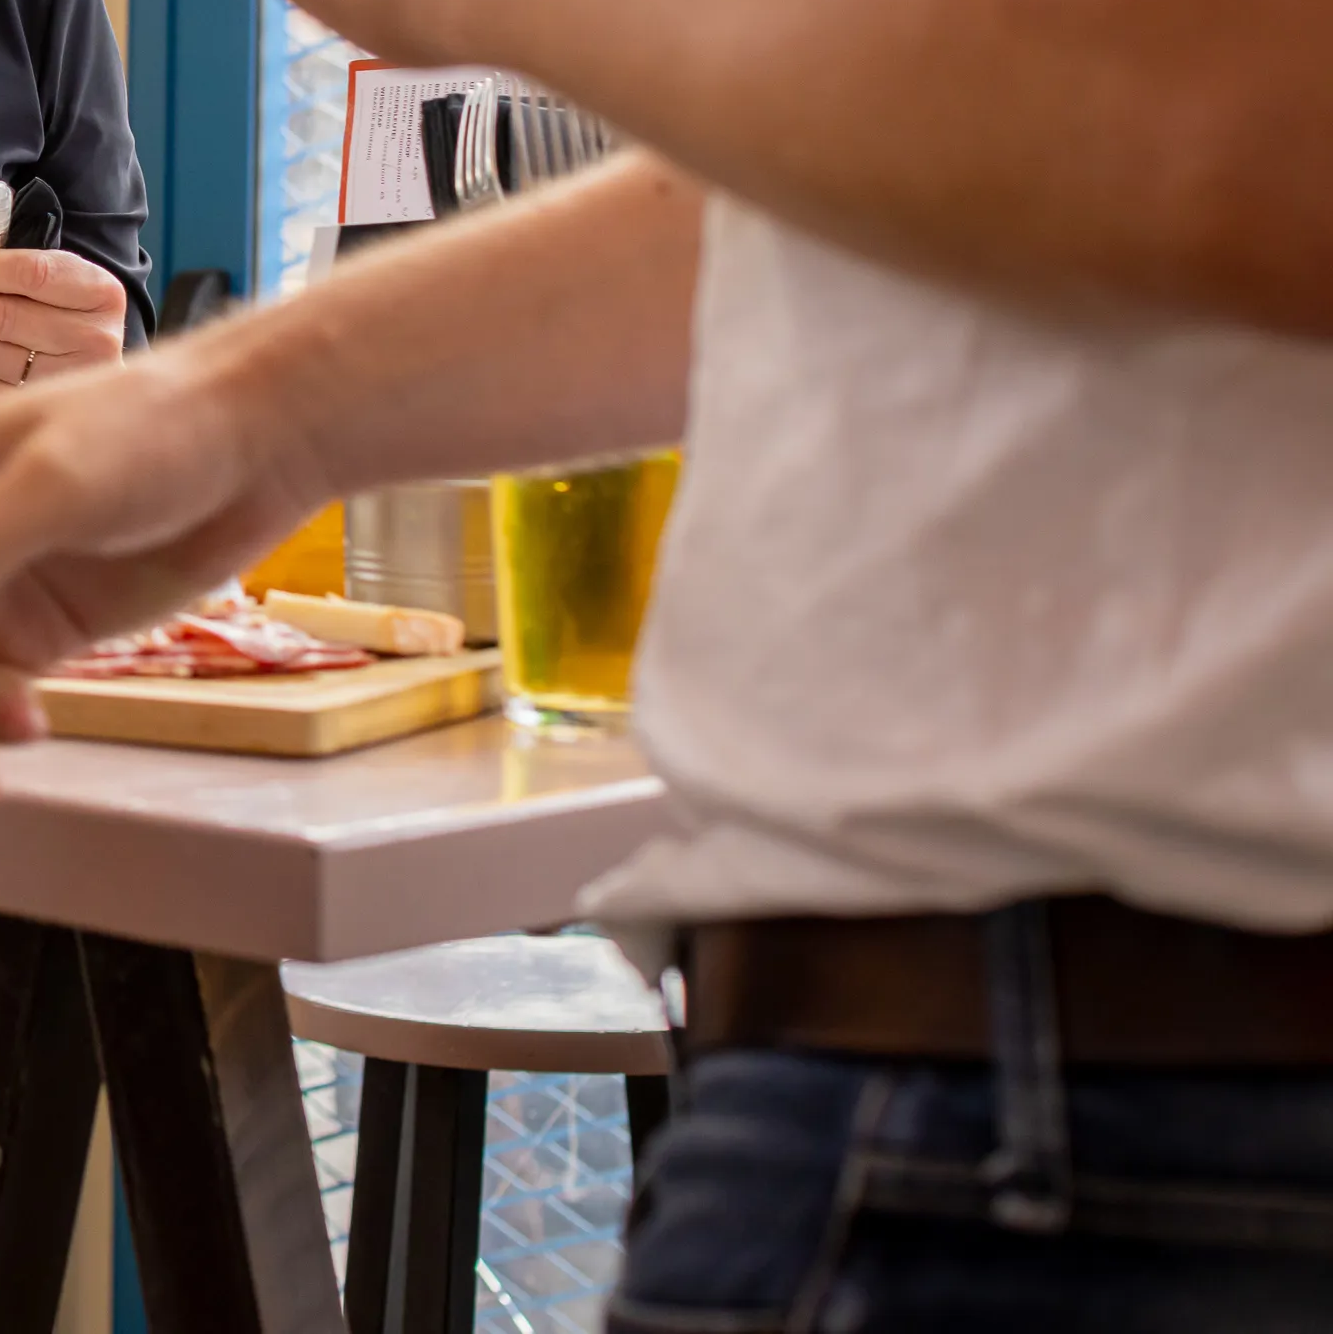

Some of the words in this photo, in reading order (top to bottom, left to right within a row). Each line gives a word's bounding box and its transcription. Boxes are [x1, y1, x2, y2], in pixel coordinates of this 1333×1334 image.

[371, 112, 376, 121] DE
[377, 86, 385, 128] WISSELTAP
[391, 85, 401, 141] MOERSLEUTEL
[407, 84, 416, 131] BROUWERIJ
